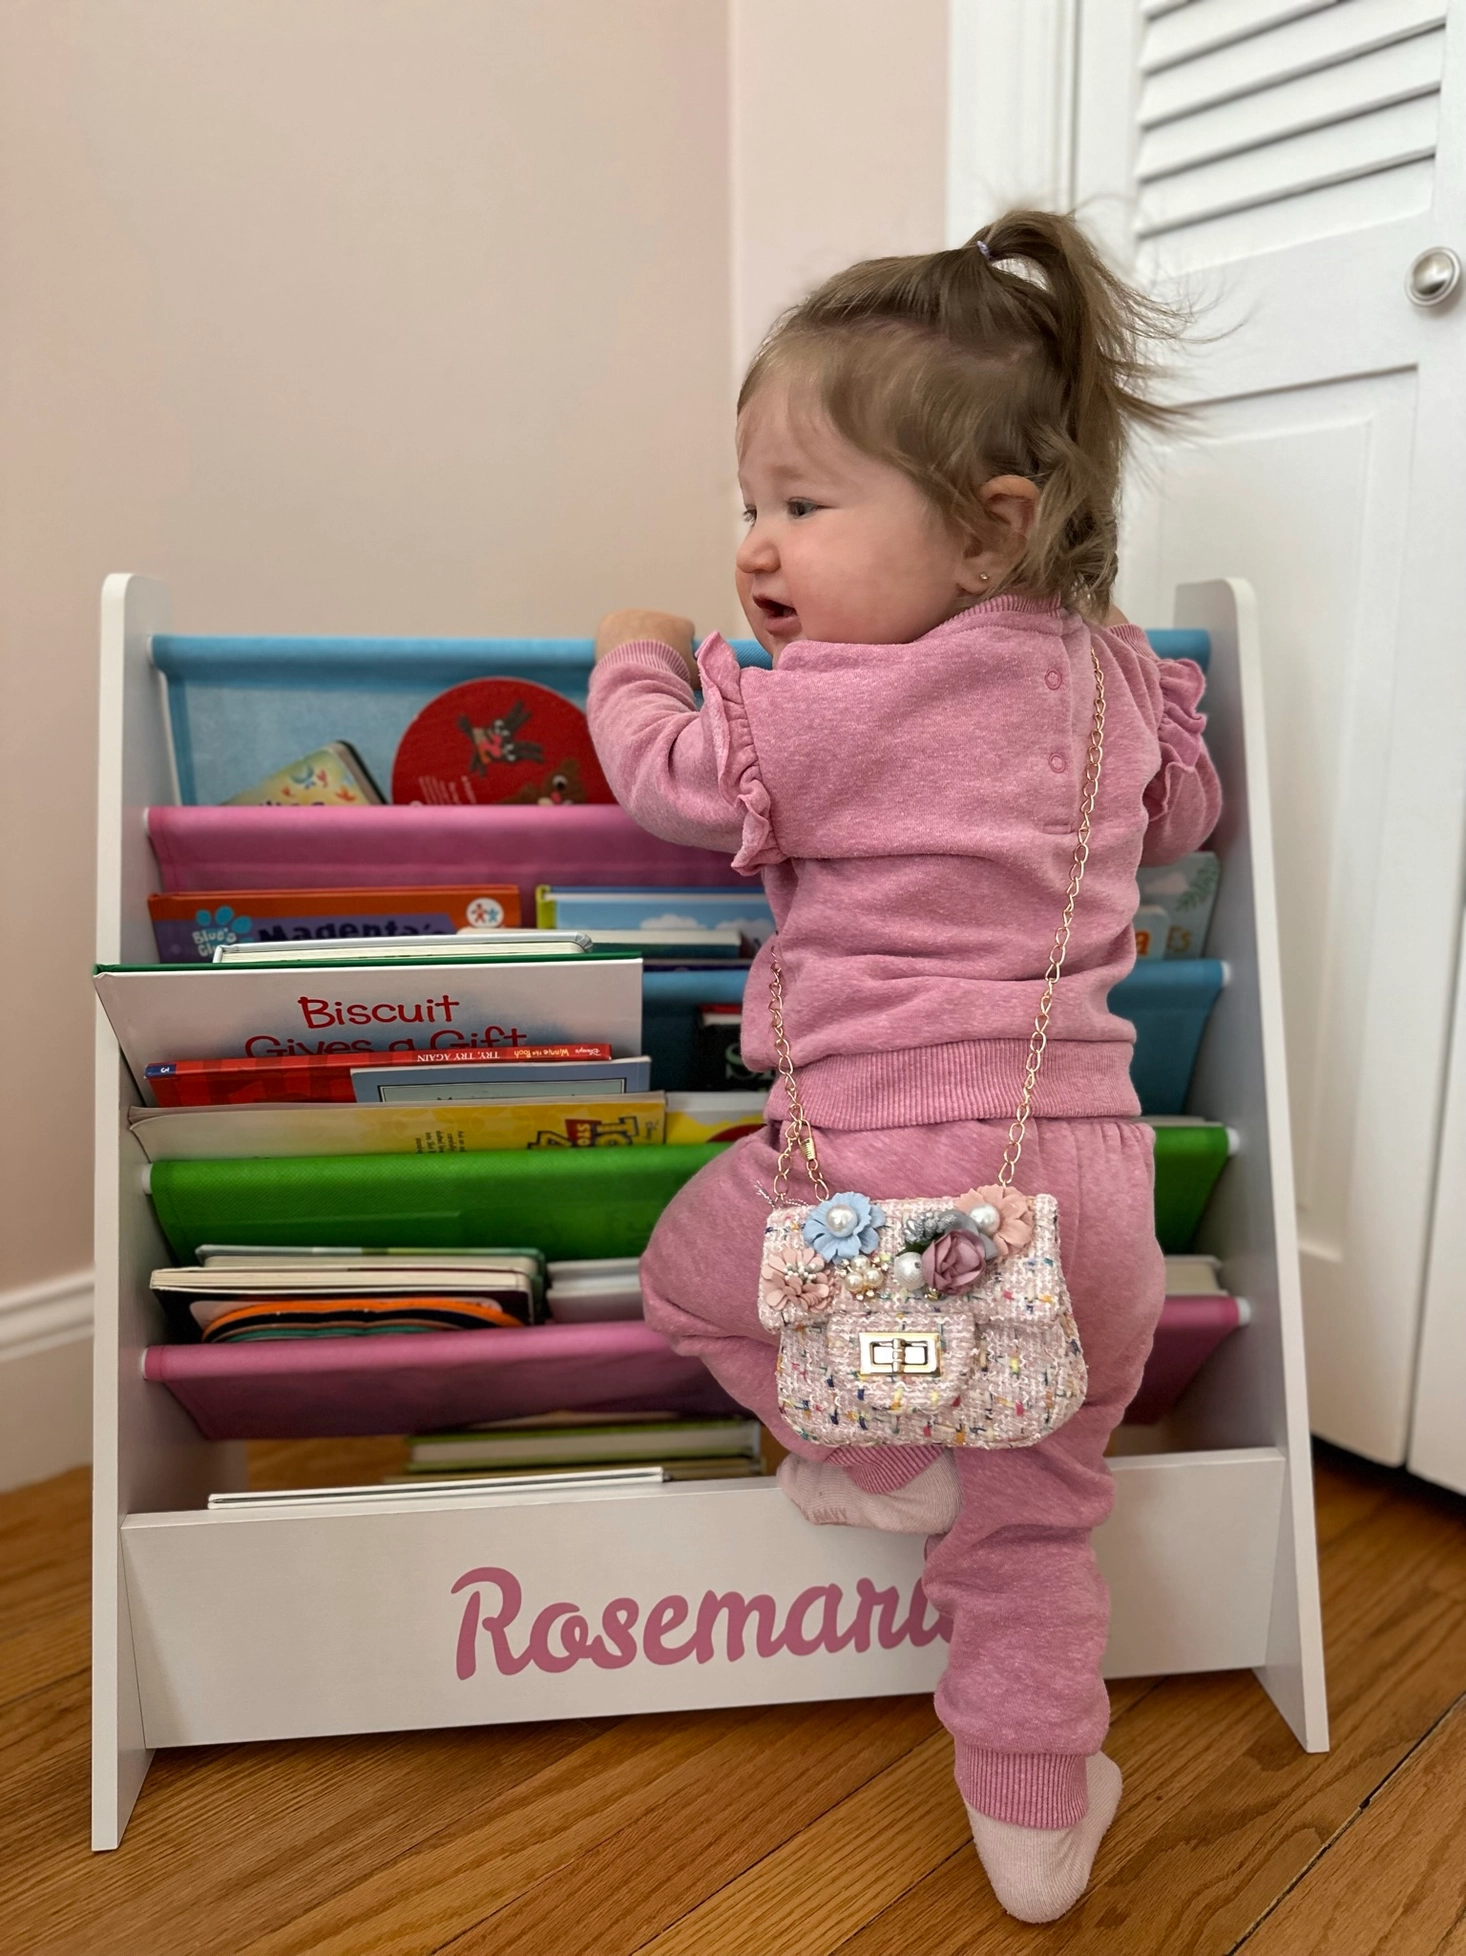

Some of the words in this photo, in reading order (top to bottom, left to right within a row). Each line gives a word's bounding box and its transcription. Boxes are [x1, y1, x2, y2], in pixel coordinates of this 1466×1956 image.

[192, 927, 237, 945] Blue's
[258, 920, 446, 941] Magenta'
[298, 995, 460, 1029] Biscuit
[245, 1036, 375, 1058] Gives
[429, 1026, 527, 1050] Gift
[416, 1053, 451, 1062] AGAIN
[454, 1052, 474, 1060] TRY
[477, 1051, 500, 1060] TRY,
[513, 1049, 531, 1058] Pooh
[543, 1048, 569, 1057] Winnie
[451, 1567, 953, 1680] Rosemari
